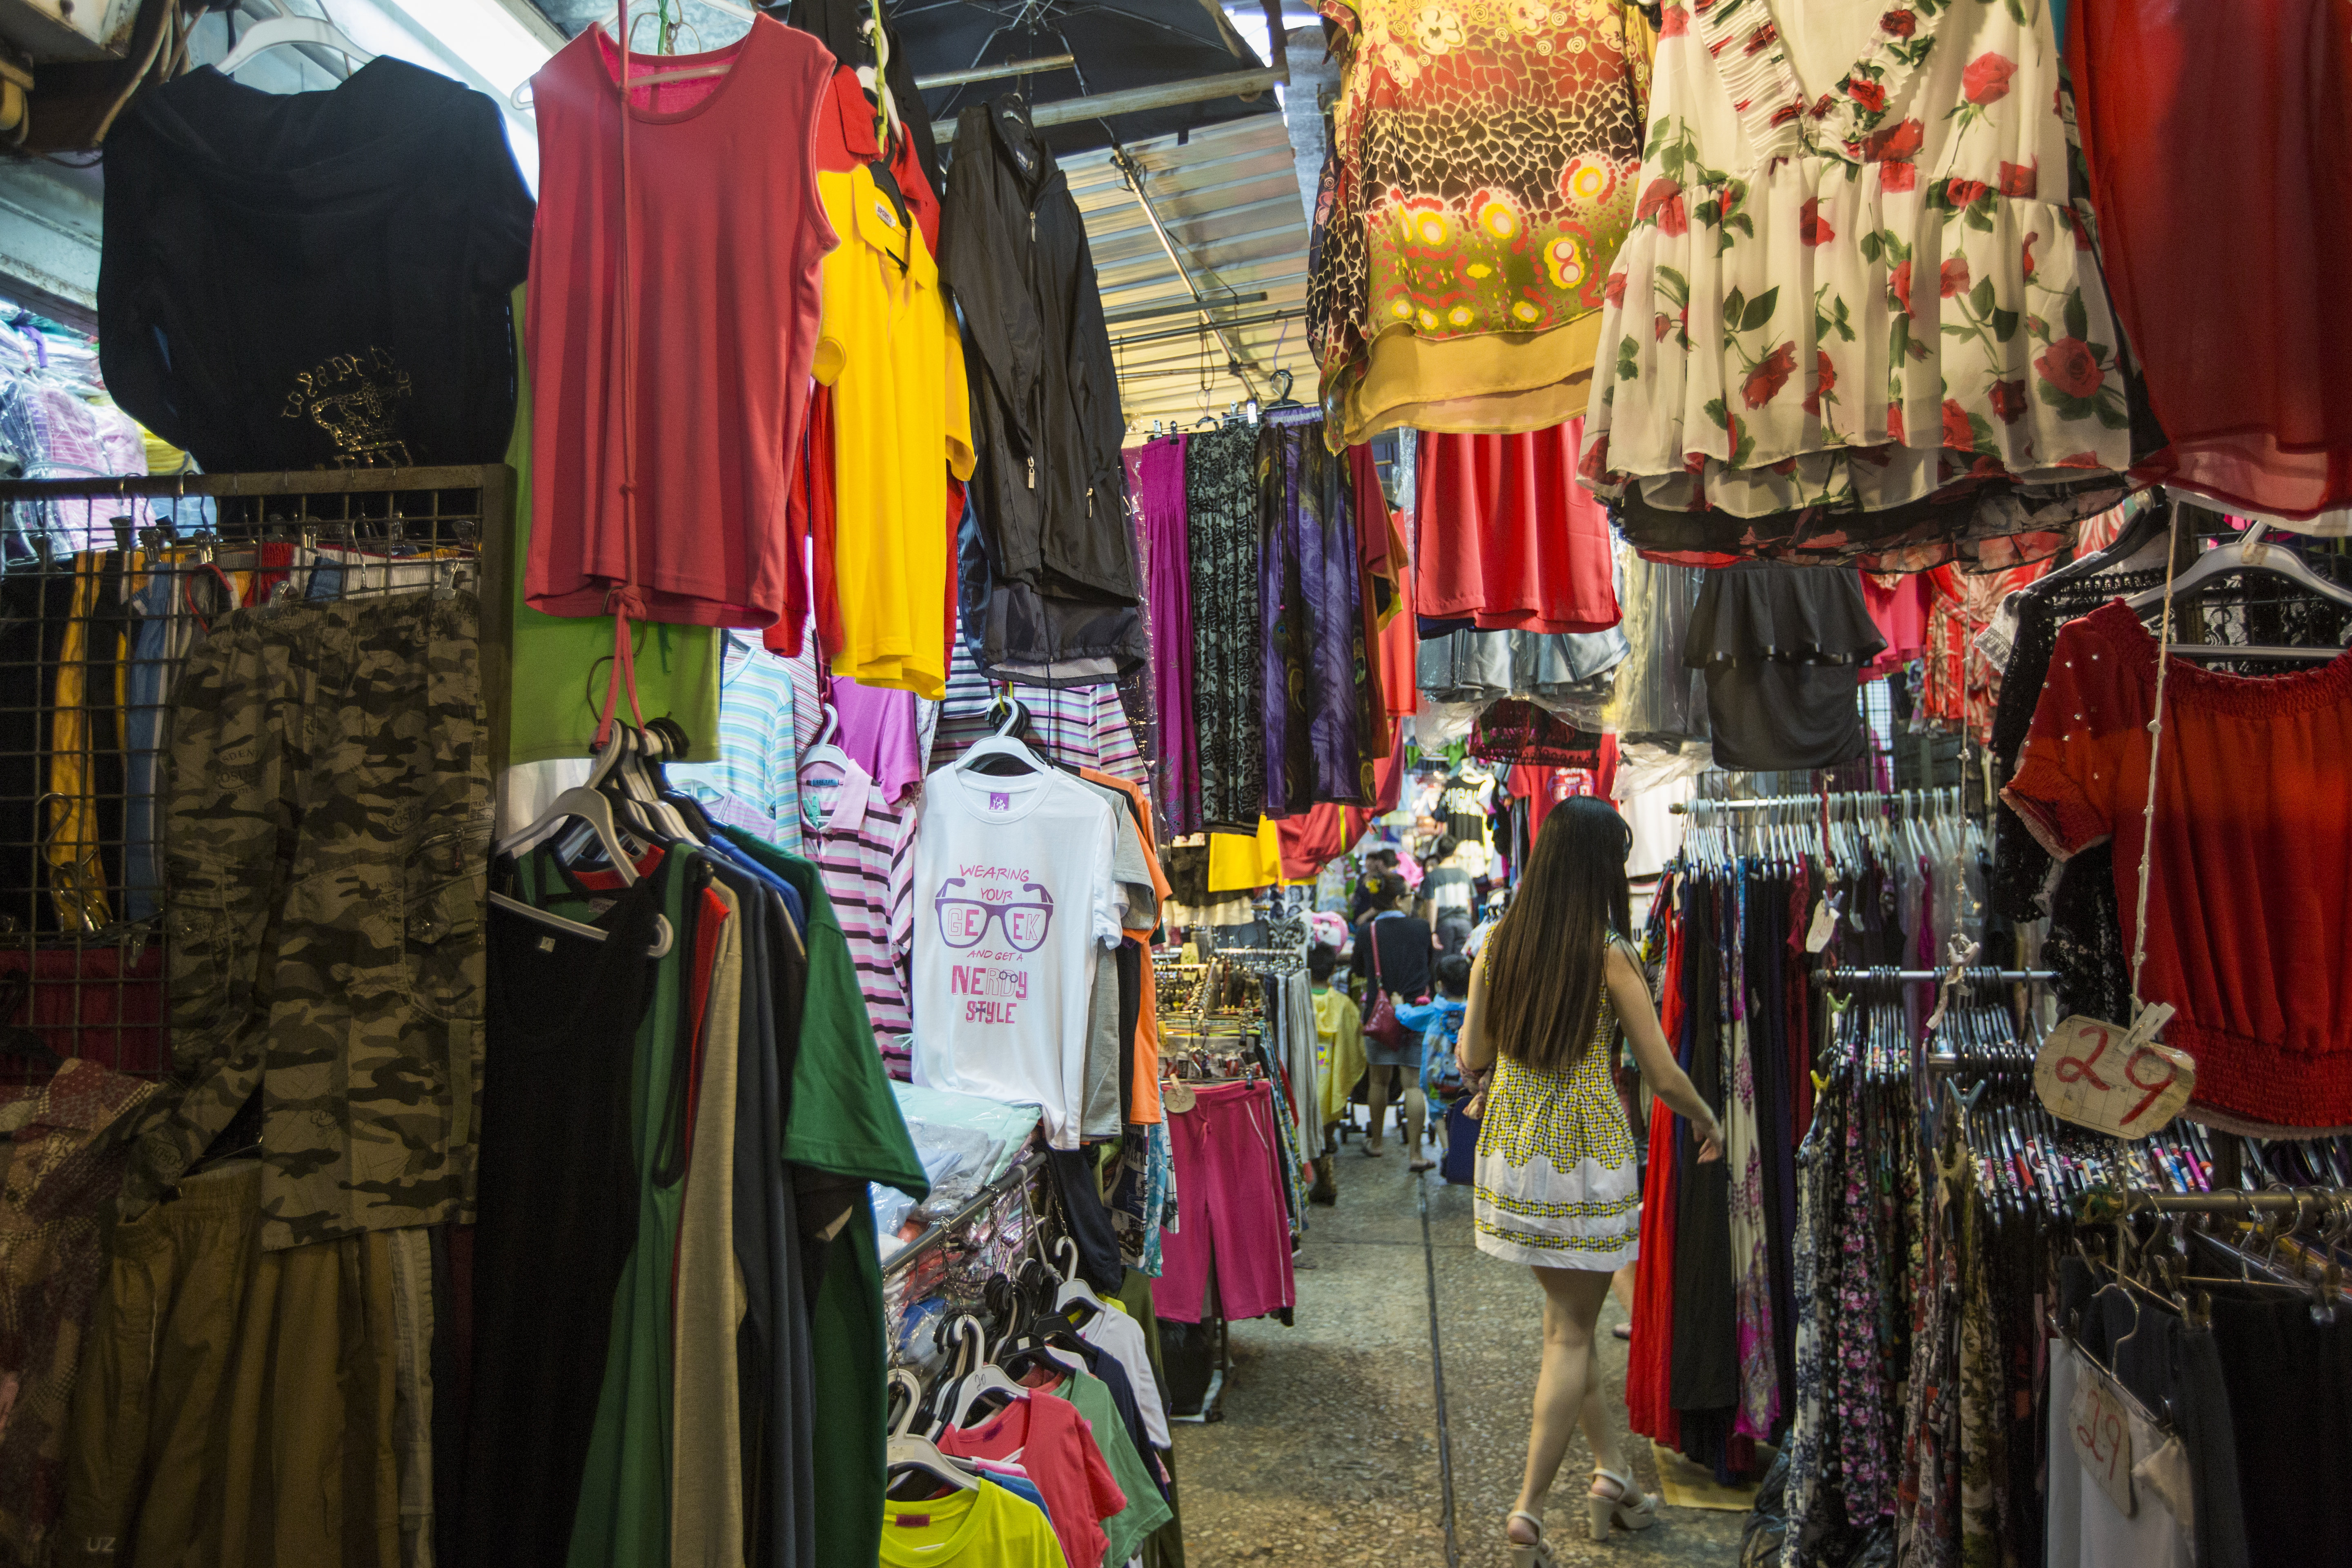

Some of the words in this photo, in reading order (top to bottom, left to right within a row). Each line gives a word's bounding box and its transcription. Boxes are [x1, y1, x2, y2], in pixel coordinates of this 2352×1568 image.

[960, 864, 1029, 882] WEARING
[981, 887, 1012, 904] YOUR
[967, 949, 993, 958] AND
[995, 952, 1016, 962] GET
[1016, 953, 1024, 962] A
[966, 1000, 1017, 1024] STYLE
[2055, 1025, 2178, 1127] 29
[2076, 1389, 2121, 1481] 29
